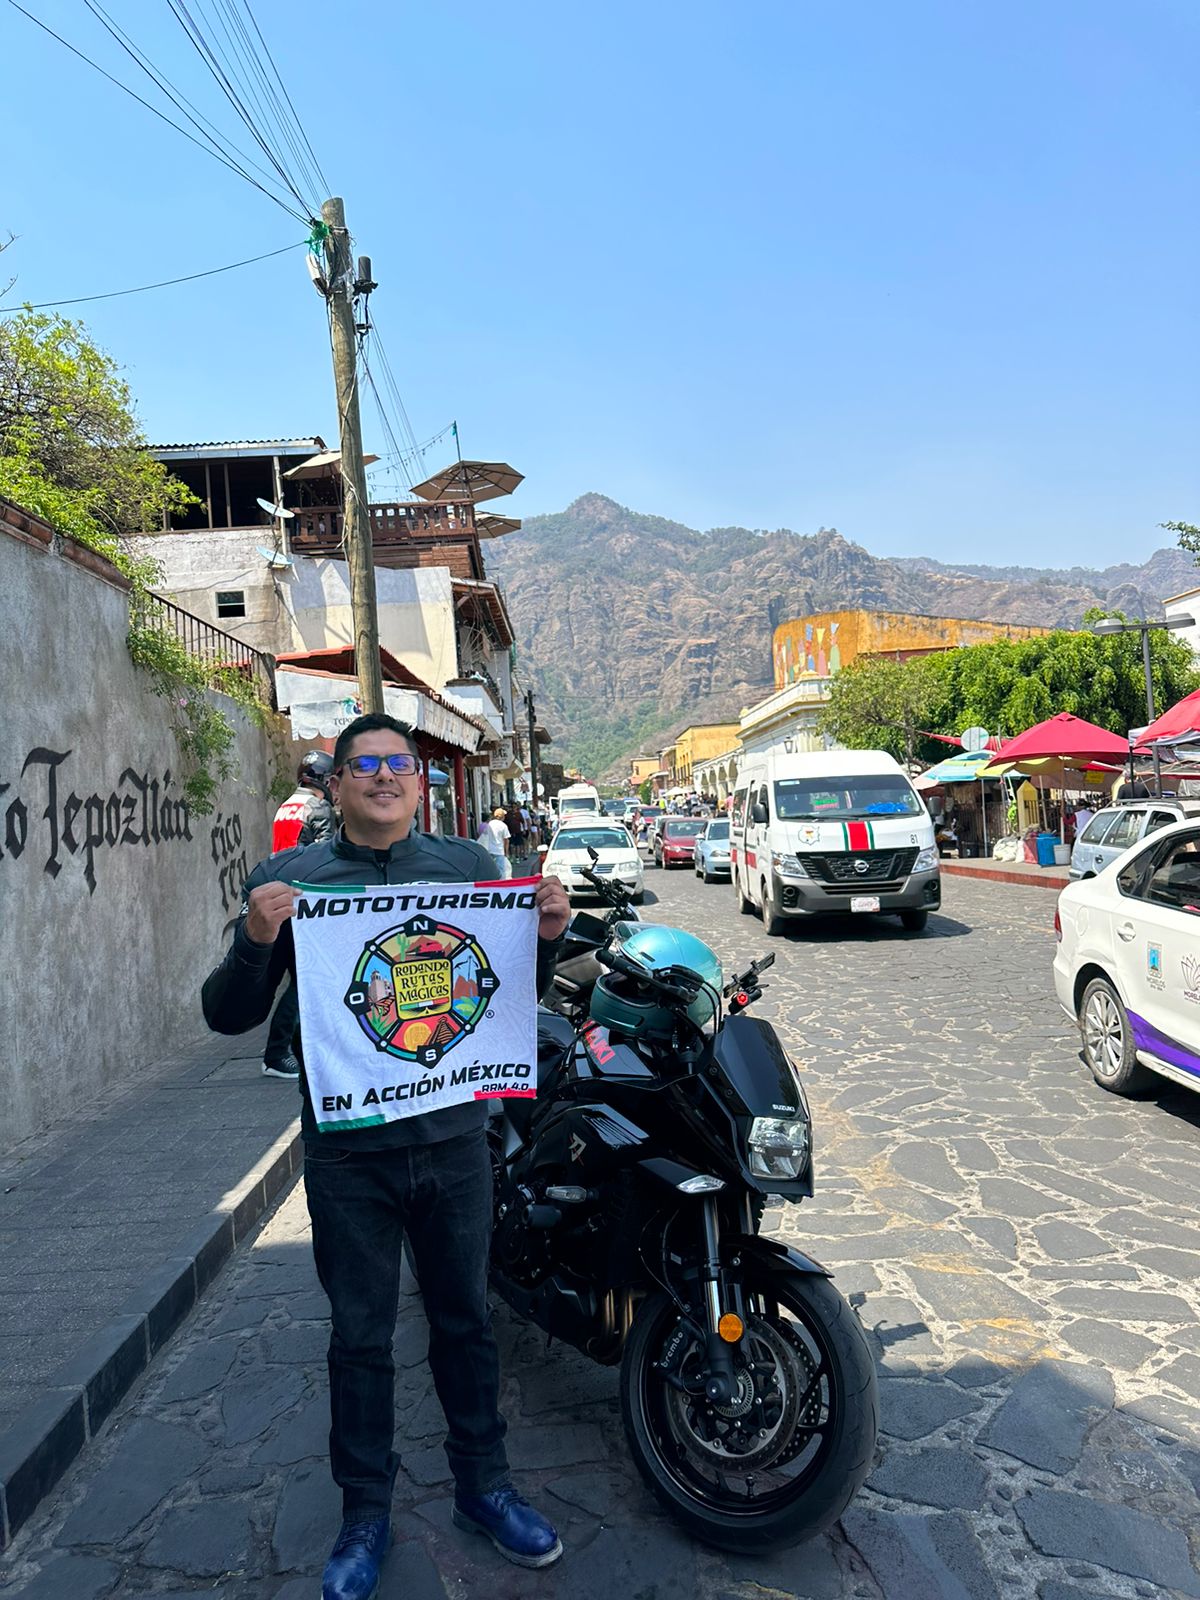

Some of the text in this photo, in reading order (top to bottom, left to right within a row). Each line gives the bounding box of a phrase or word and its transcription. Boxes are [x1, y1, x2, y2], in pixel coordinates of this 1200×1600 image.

[297, 892, 536, 919] MOTOTURISMO
[413, 920, 429, 931] N
[481, 977, 494, 988] E
[425, 1049, 437, 1061] S
[322, 1060, 531, 1112] EN ACCIÓN MÉXICO
[482, 1082, 529, 1093] RRM 4.0
[660, 1331, 684, 1368] brembo
